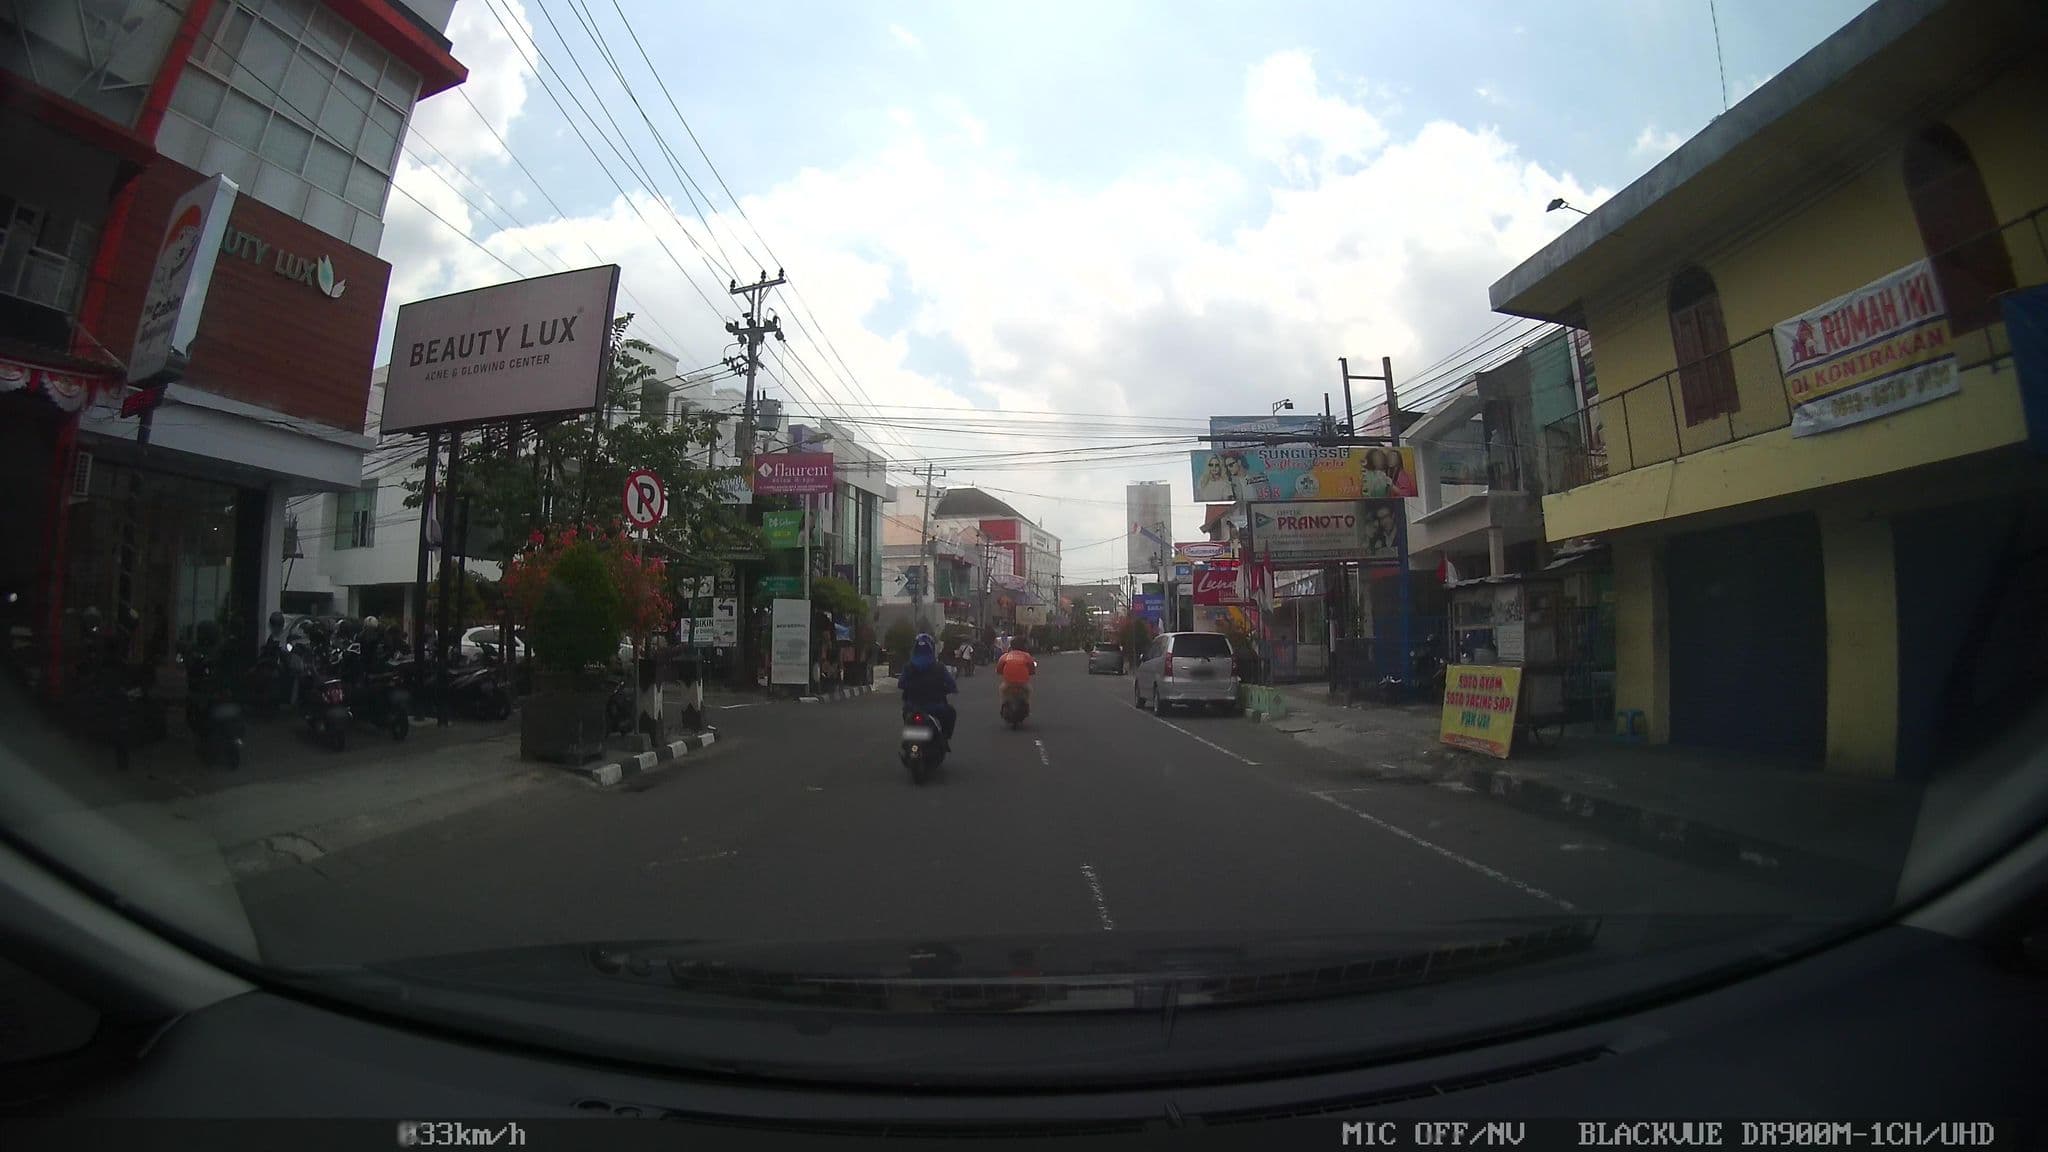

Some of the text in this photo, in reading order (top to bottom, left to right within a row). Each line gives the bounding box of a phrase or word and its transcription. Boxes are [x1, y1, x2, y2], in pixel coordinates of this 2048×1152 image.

[221, 225, 317, 287] UTY LUX
[1820, 272, 1937, 353] RUMAH INI
[409, 315, 578, 368] BEAUTY LUX
[1791, 378, 1811, 395] DI
[1815, 327, 1945, 388] KONTRAKAN
[425, 369, 449, 382] ACNE
[461, 360, 506, 376] GLOWING
[509, 354, 551, 370] CENTER
[774, 462, 828, 477] flaurent
[1277, 514, 1356, 530] PRANOTO
[1459, 673, 1478, 689] SOTO
